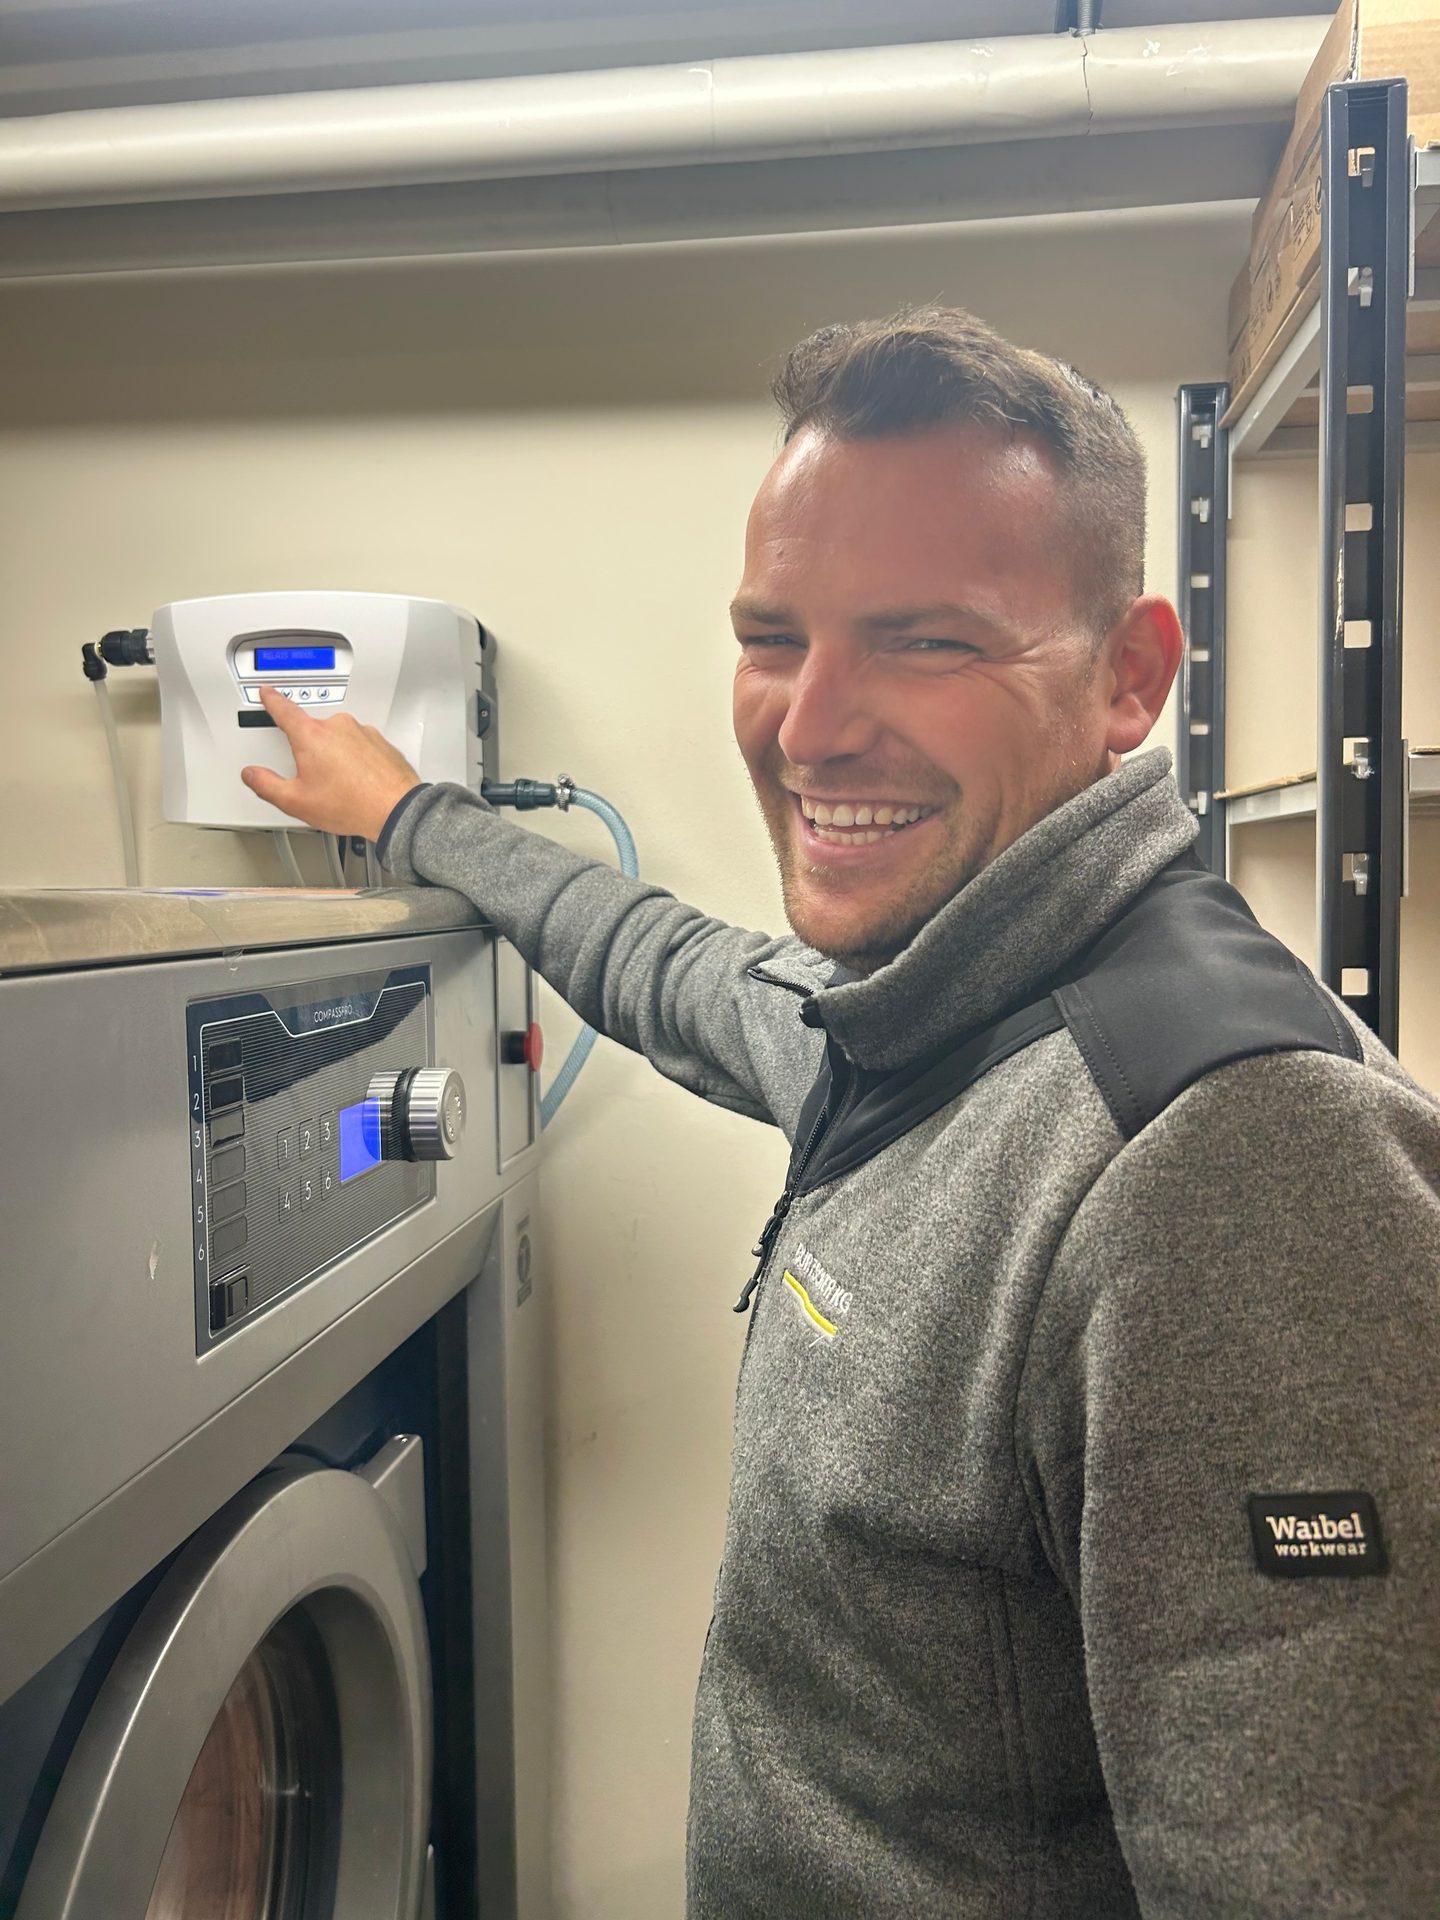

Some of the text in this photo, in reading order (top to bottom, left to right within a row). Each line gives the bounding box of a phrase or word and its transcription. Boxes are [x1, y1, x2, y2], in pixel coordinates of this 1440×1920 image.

[314, 1004, 353, 1023] COMPASSPRO
[192, 1055, 197, 1072] 1
[193, 1092, 200, 1111] 2
[194, 1129, 201, 1148] 3
[283, 1121, 331, 1159] 1 2 3
[195, 1168, 203, 1184] 4
[283, 1170, 332, 1210] 4 5 6
[197, 1205, 204, 1223] 5
[198, 1243, 205, 1261] 6
[1265, 1512, 1364, 1540] Waibel
[1274, 1541, 1367, 1557] workwear
